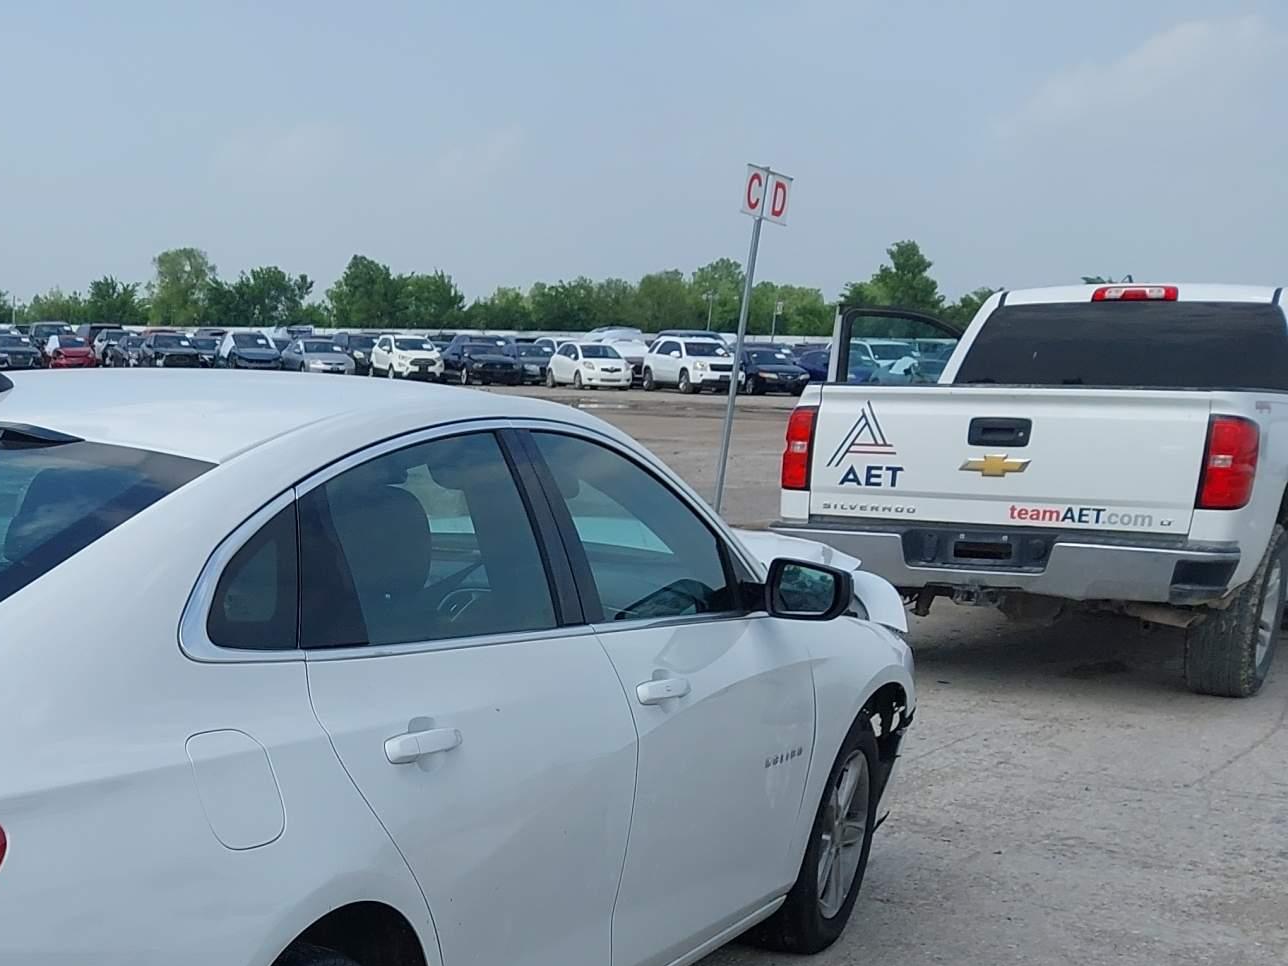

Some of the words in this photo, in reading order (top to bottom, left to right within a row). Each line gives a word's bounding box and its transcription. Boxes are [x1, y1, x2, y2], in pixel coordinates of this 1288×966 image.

[747, 172, 762, 210] C
[771, 181, 787, 217] D
[838, 465, 905, 487] AET
[1009, 504, 1153, 527] teamAET.com
